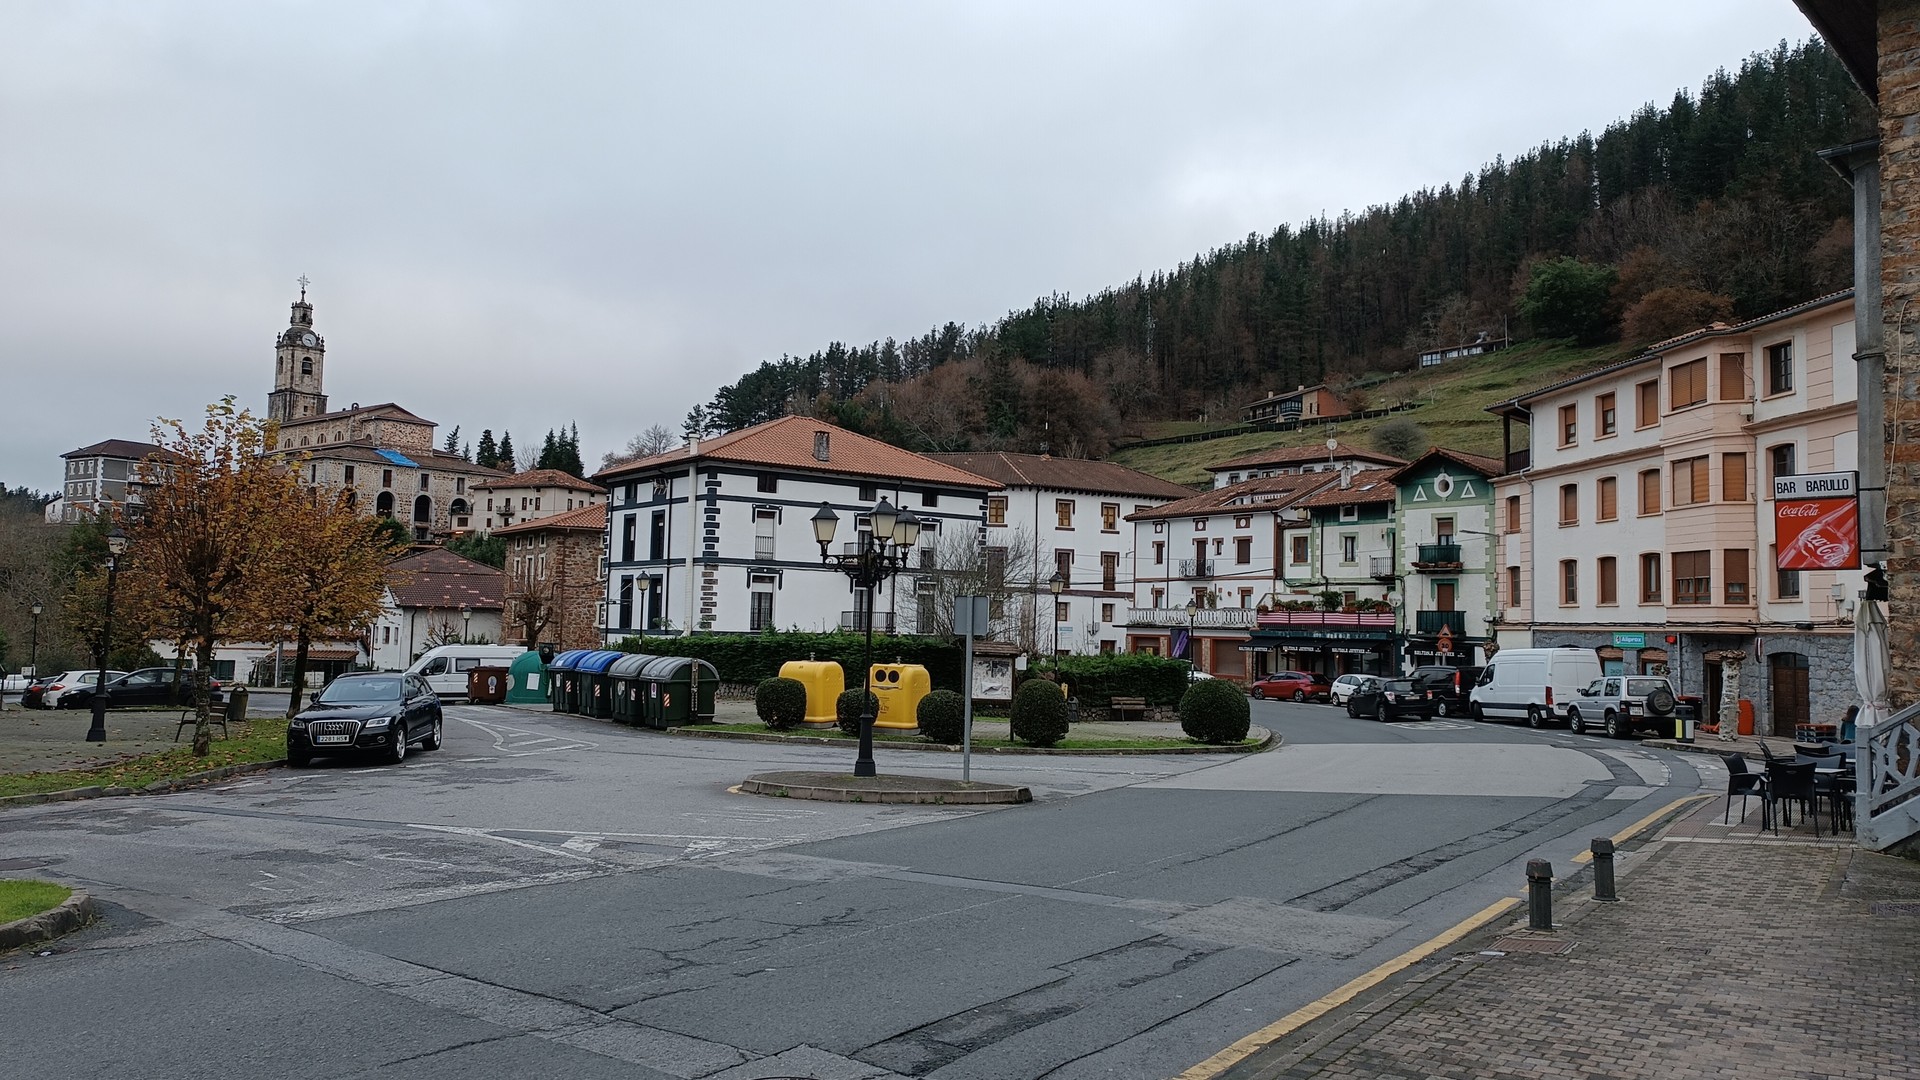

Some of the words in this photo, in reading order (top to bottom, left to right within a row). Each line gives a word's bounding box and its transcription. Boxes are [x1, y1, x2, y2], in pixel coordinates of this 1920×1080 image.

[1776, 481, 1796, 494] BAR
[1806, 478, 1849, 493] BARULLO
[1778, 503, 1820, 518] Coca-Cola
